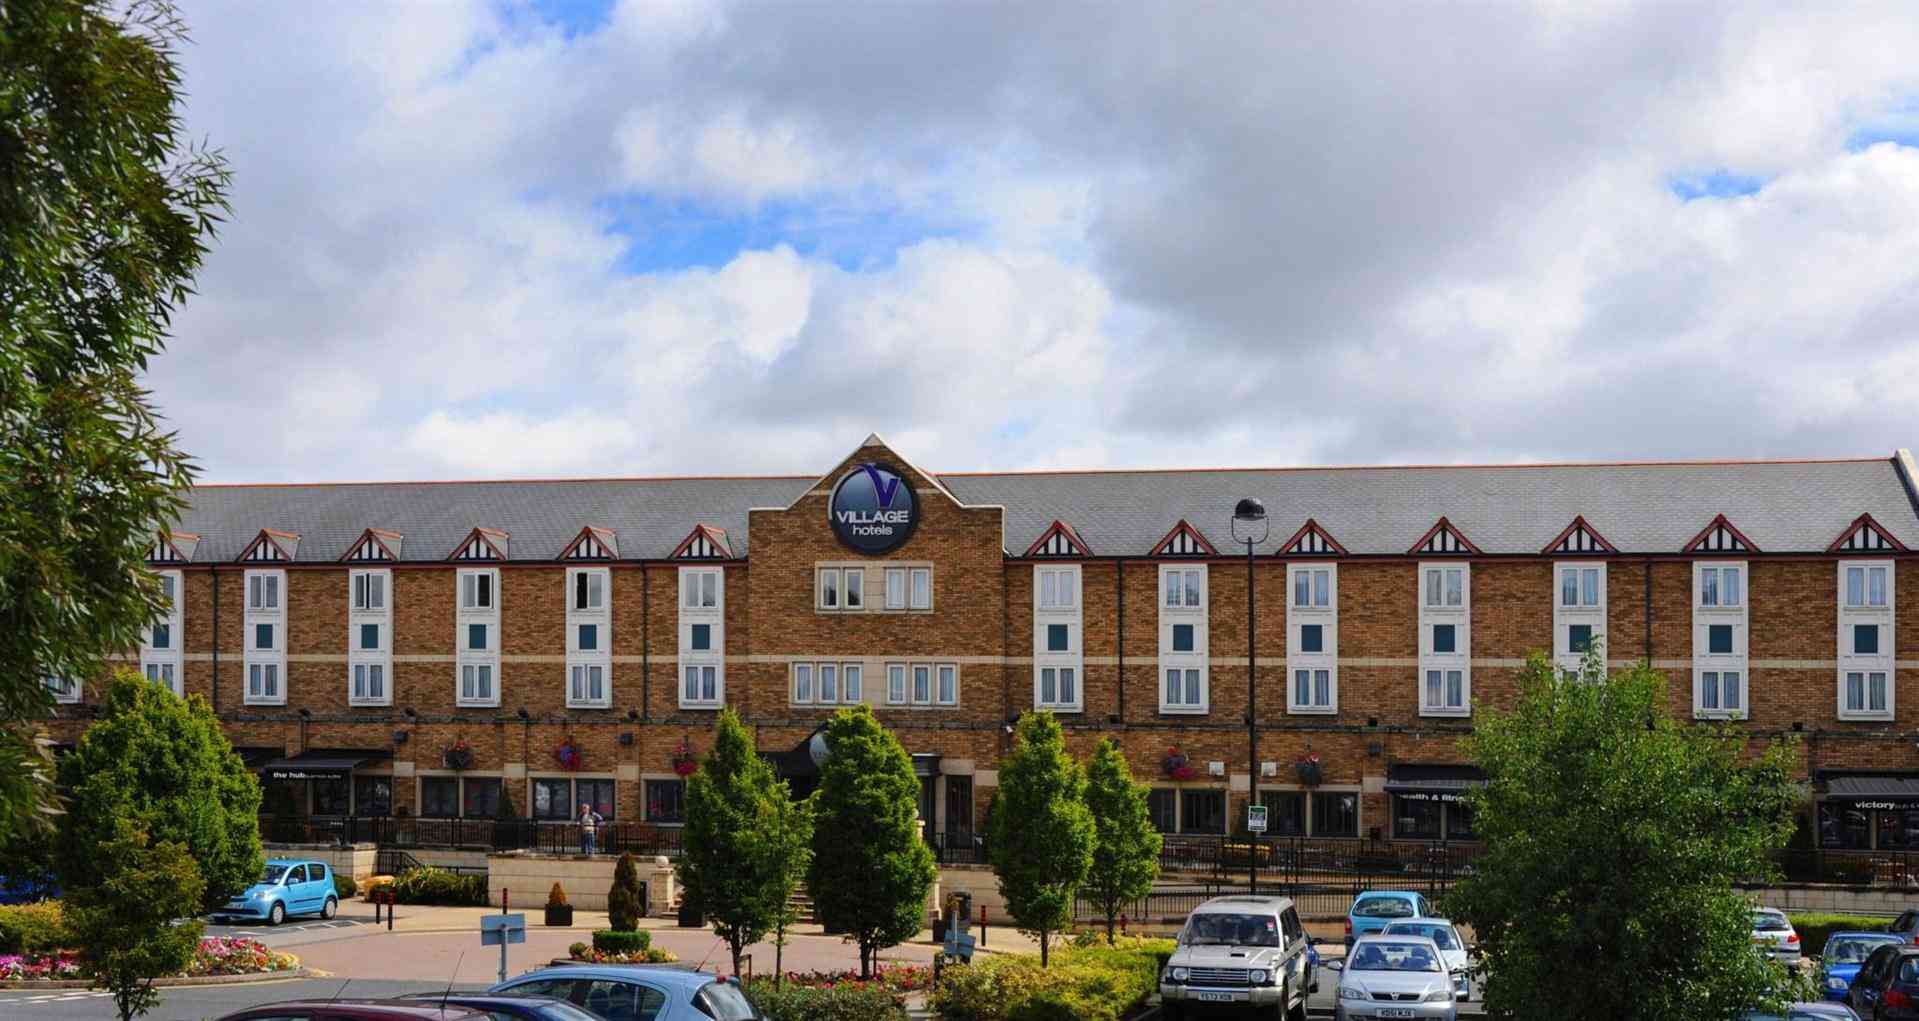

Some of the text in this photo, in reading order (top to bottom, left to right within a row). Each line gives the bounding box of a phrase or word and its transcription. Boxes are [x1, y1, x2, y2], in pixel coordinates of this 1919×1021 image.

[853, 463, 900, 508] V
[836, 510, 909, 523] VILLAGE
[852, 524, 893, 536] hotels
[273, 771, 288, 779] the
[288, 771, 305, 779] hub
[1855, 800, 1896, 810] victory
